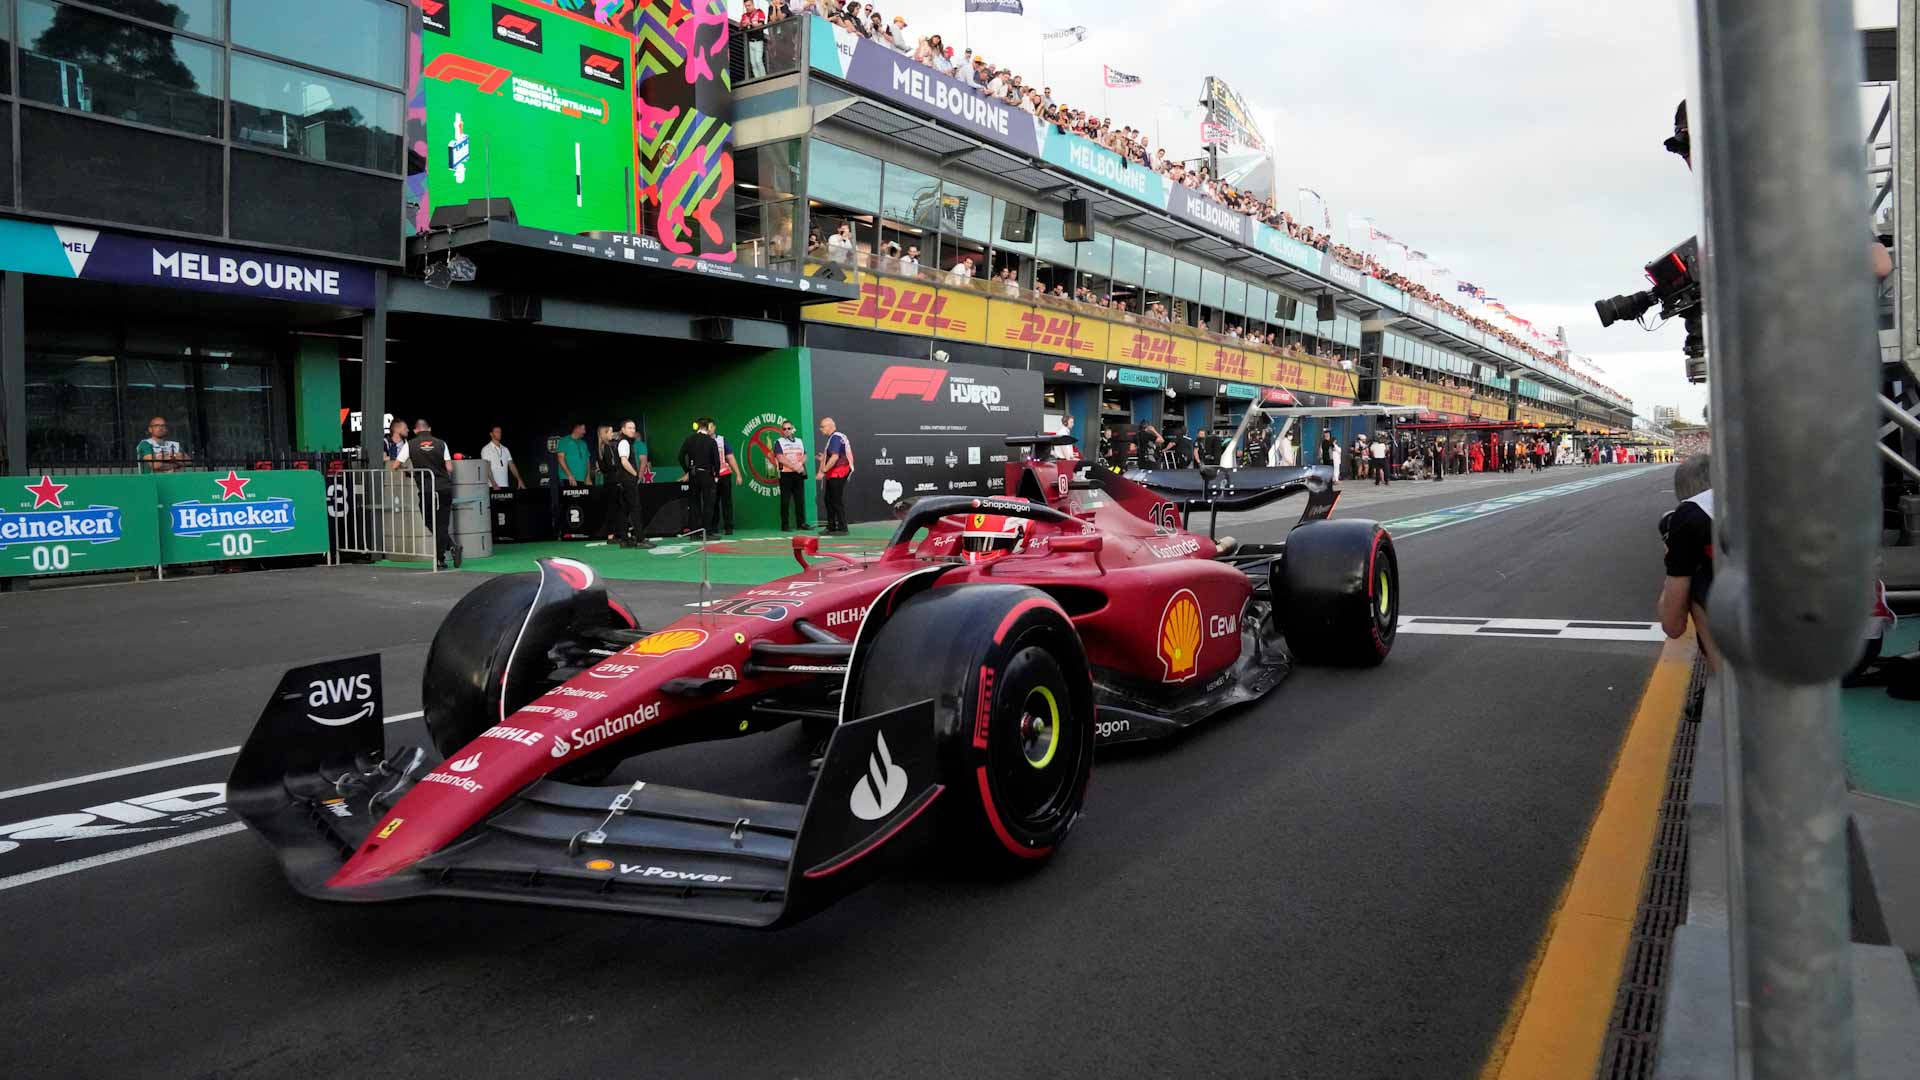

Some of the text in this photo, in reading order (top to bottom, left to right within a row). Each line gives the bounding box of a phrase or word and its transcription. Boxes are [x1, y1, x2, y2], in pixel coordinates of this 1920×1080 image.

[893, 60, 1009, 136] MELBOURNE
[1069, 142, 1147, 194] MELBOURNE
[1186, 193, 1241, 236] MELBOURNE
[62, 241, 91, 254] MEL
[152, 247, 340, 295] MELBOURNE
[857, 282, 951, 330] DHL
[1018, 311, 1083, 349] DHL
[1131, 333, 1179, 364] DHL
[1211, 350, 1249, 377] DHL
[742, 415, 761, 436] WHEN
[761, 413, 776, 424] YOU
[749, 480, 771, 497] NEVER
[179, 506, 288, 528] Heineken
[982, 500, 1031, 513] Snapdragon
[1149, 502, 1177, 536] 16
[0, 514, 113, 540] eineken
[747, 589, 813, 597] VELAS
[309, 673, 373, 707] aws
[559, 686, 608, 700] Palantir
[972, 664, 995, 749] PIRELLI
[479, 726, 545, 747] MAHLE
[571, 701, 662, 751] Santander
[618, 863, 732, 884] V-Power
